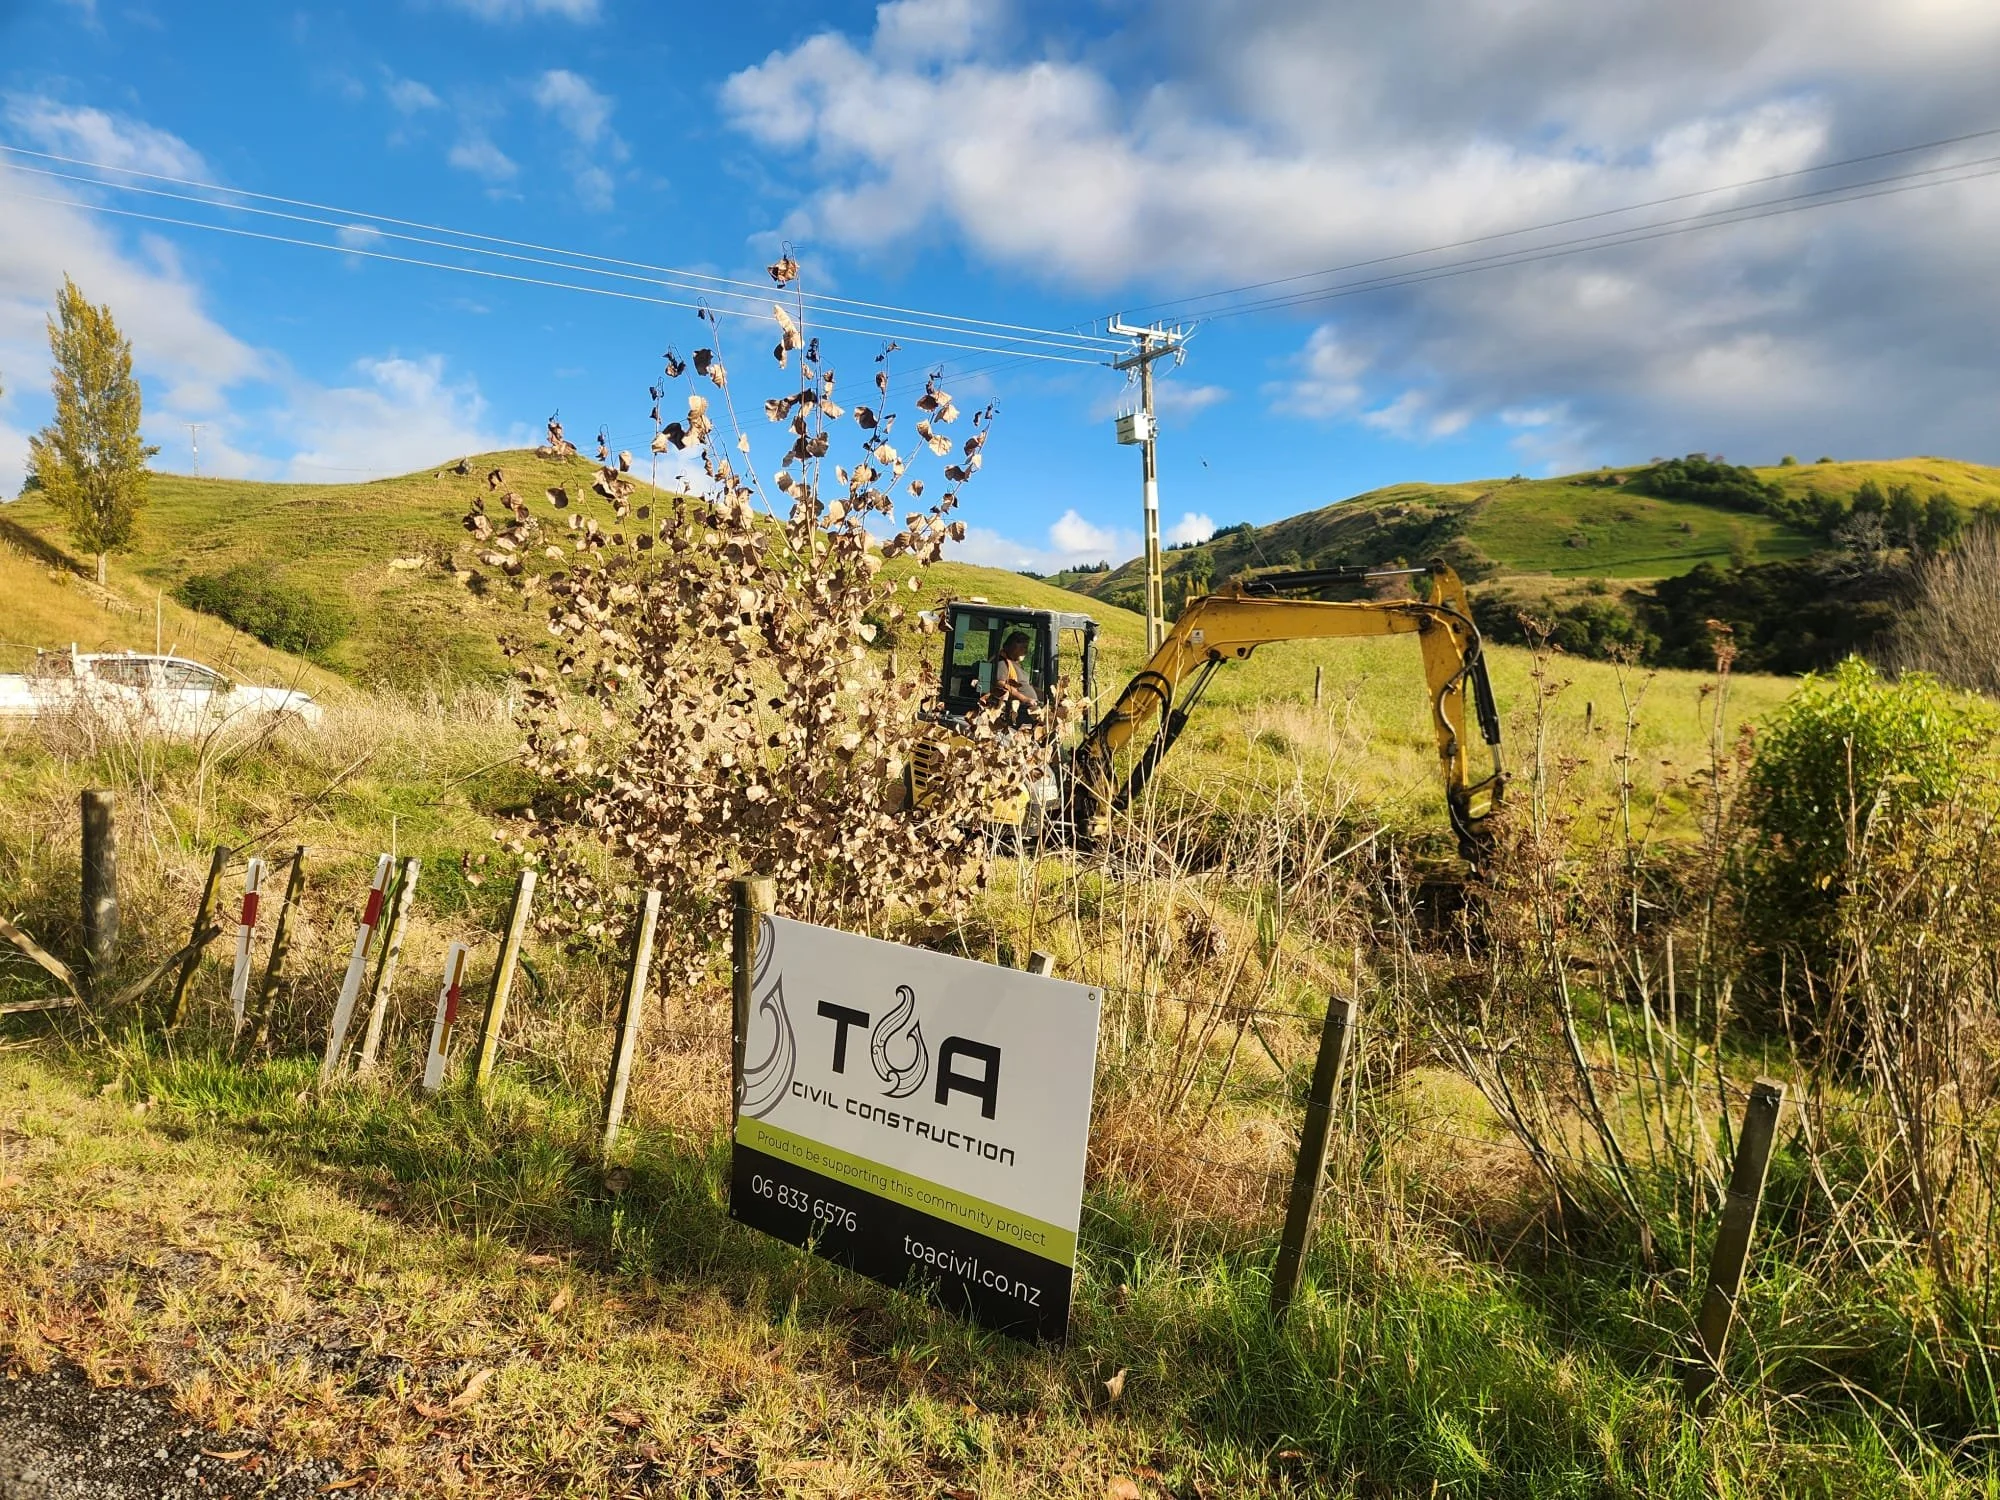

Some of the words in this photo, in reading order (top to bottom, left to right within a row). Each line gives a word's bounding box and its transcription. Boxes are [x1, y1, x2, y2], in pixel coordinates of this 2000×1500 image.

[792, 1081, 838, 1109] CIVIL
[845, 1098, 1014, 1167] CONSTRUCTION
[752, 1174, 774, 1199] 06
[777, 1184, 809, 1213] 833
[813, 1199, 857, 1232] 6576
[757, 1130, 790, 1152] Proud
[792, 1144, 803, 1157] to
[806, 1148, 820, 1163] be
[822, 1156, 887, 1191] supporting
[891, 1179, 914, 1198] this
[916, 1190, 993, 1228] community
[996, 1219, 1046, 1246] project
[904, 1234, 1041, 1307] toacivil.co.nz
